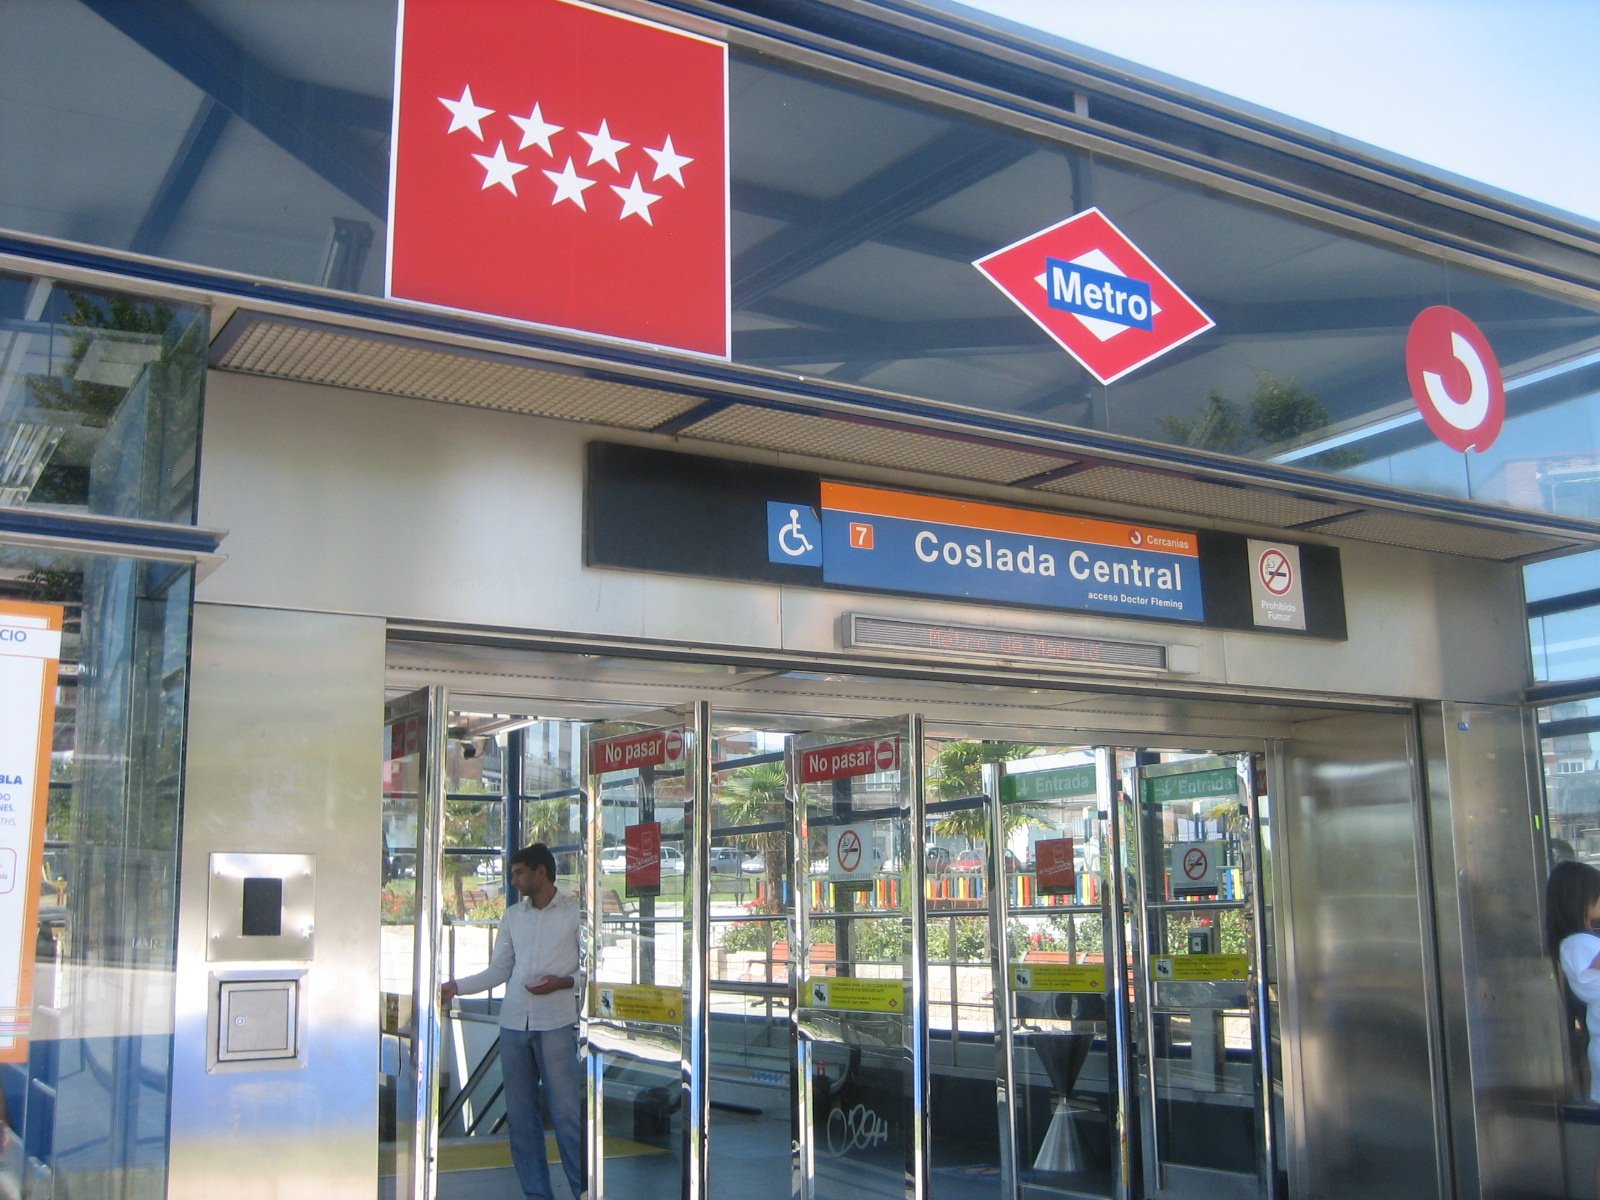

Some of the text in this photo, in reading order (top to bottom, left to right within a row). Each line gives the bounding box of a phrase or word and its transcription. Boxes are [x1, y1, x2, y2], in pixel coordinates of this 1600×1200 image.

[1052, 266, 1149, 322] Metro
[854, 526, 869, 546] 7
[914, 530, 1182, 591] Coslada Central
[1088, 591, 1183, 610] acceso Doctor Fleming
[1000, 635, 1023, 654] de
[1034, 638, 1101, 660] Madrid
[605, 739, 663, 765] No pasar
[809, 750, 872, 775] No pasar
[1035, 773, 1091, 793] Entrada
[1178, 776, 1234, 795] Entrada
